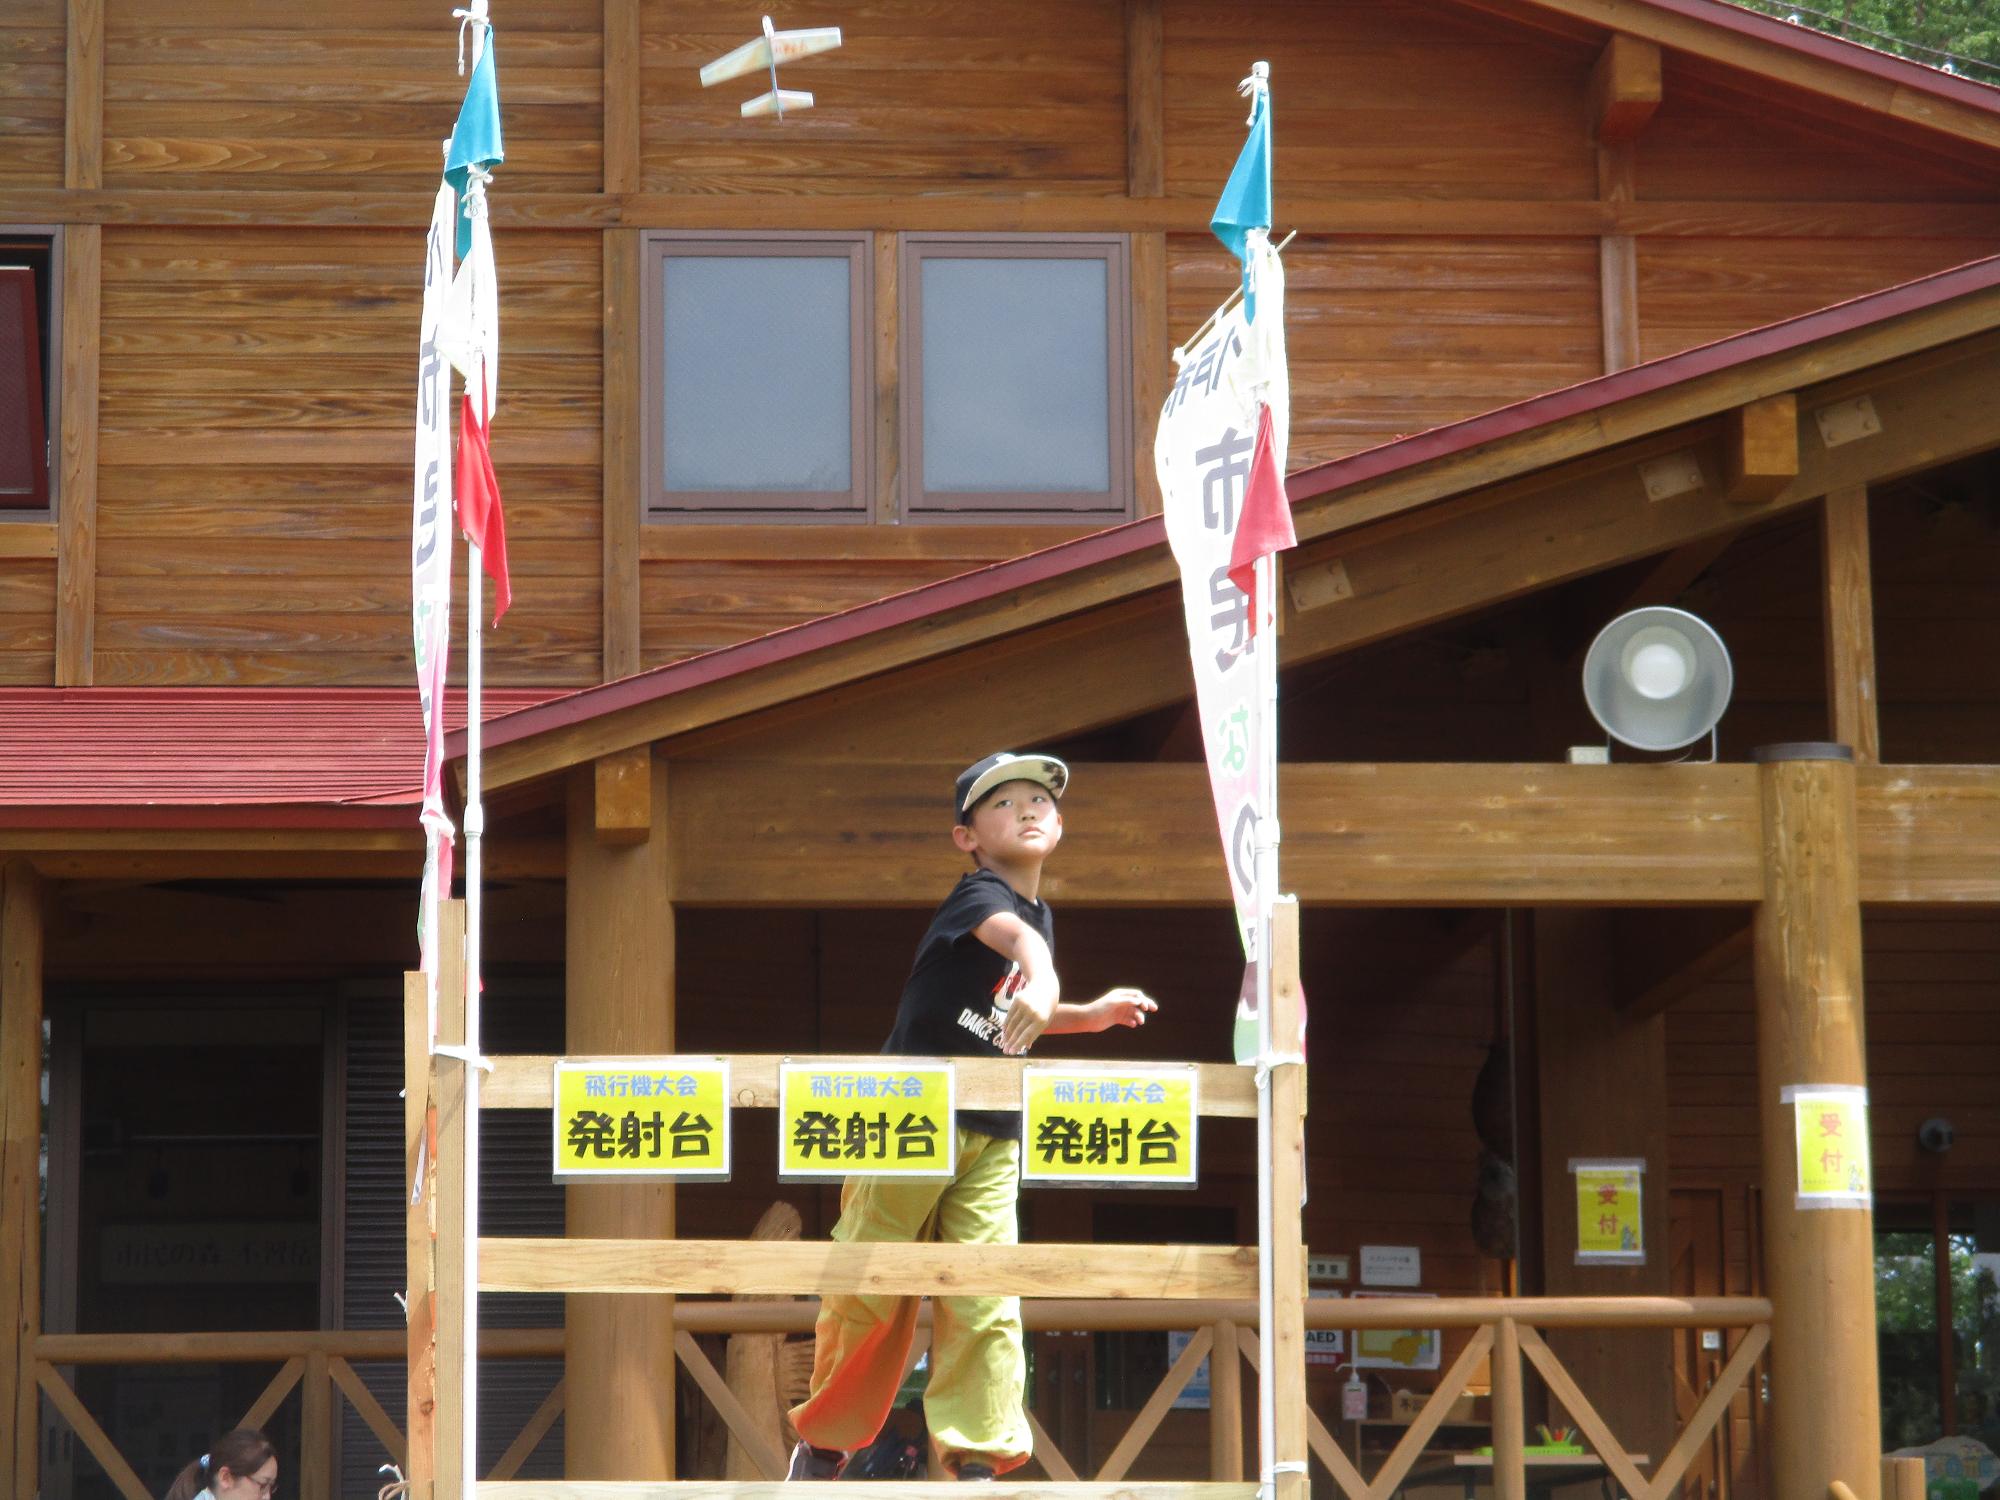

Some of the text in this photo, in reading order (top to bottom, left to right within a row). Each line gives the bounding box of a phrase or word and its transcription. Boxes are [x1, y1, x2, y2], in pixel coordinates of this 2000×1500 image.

[957, 1008, 998, 1041] DANCE
[585, 1074, 698, 1097] 飛行機大会
[810, 1075, 923, 1098] 飛行機大会
[1053, 1081, 1166, 1104] 飛行機大会
[567, 1110, 714, 1159] 発射台
[793, 1111, 938, 1160] 発射台
[1036, 1116, 1181, 1165] 発射台
[1819, 1112, 1843, 1174] 受付
[1597, 1183, 1618, 1235] 受付
[1305, 1331, 1336, 1343] AED
